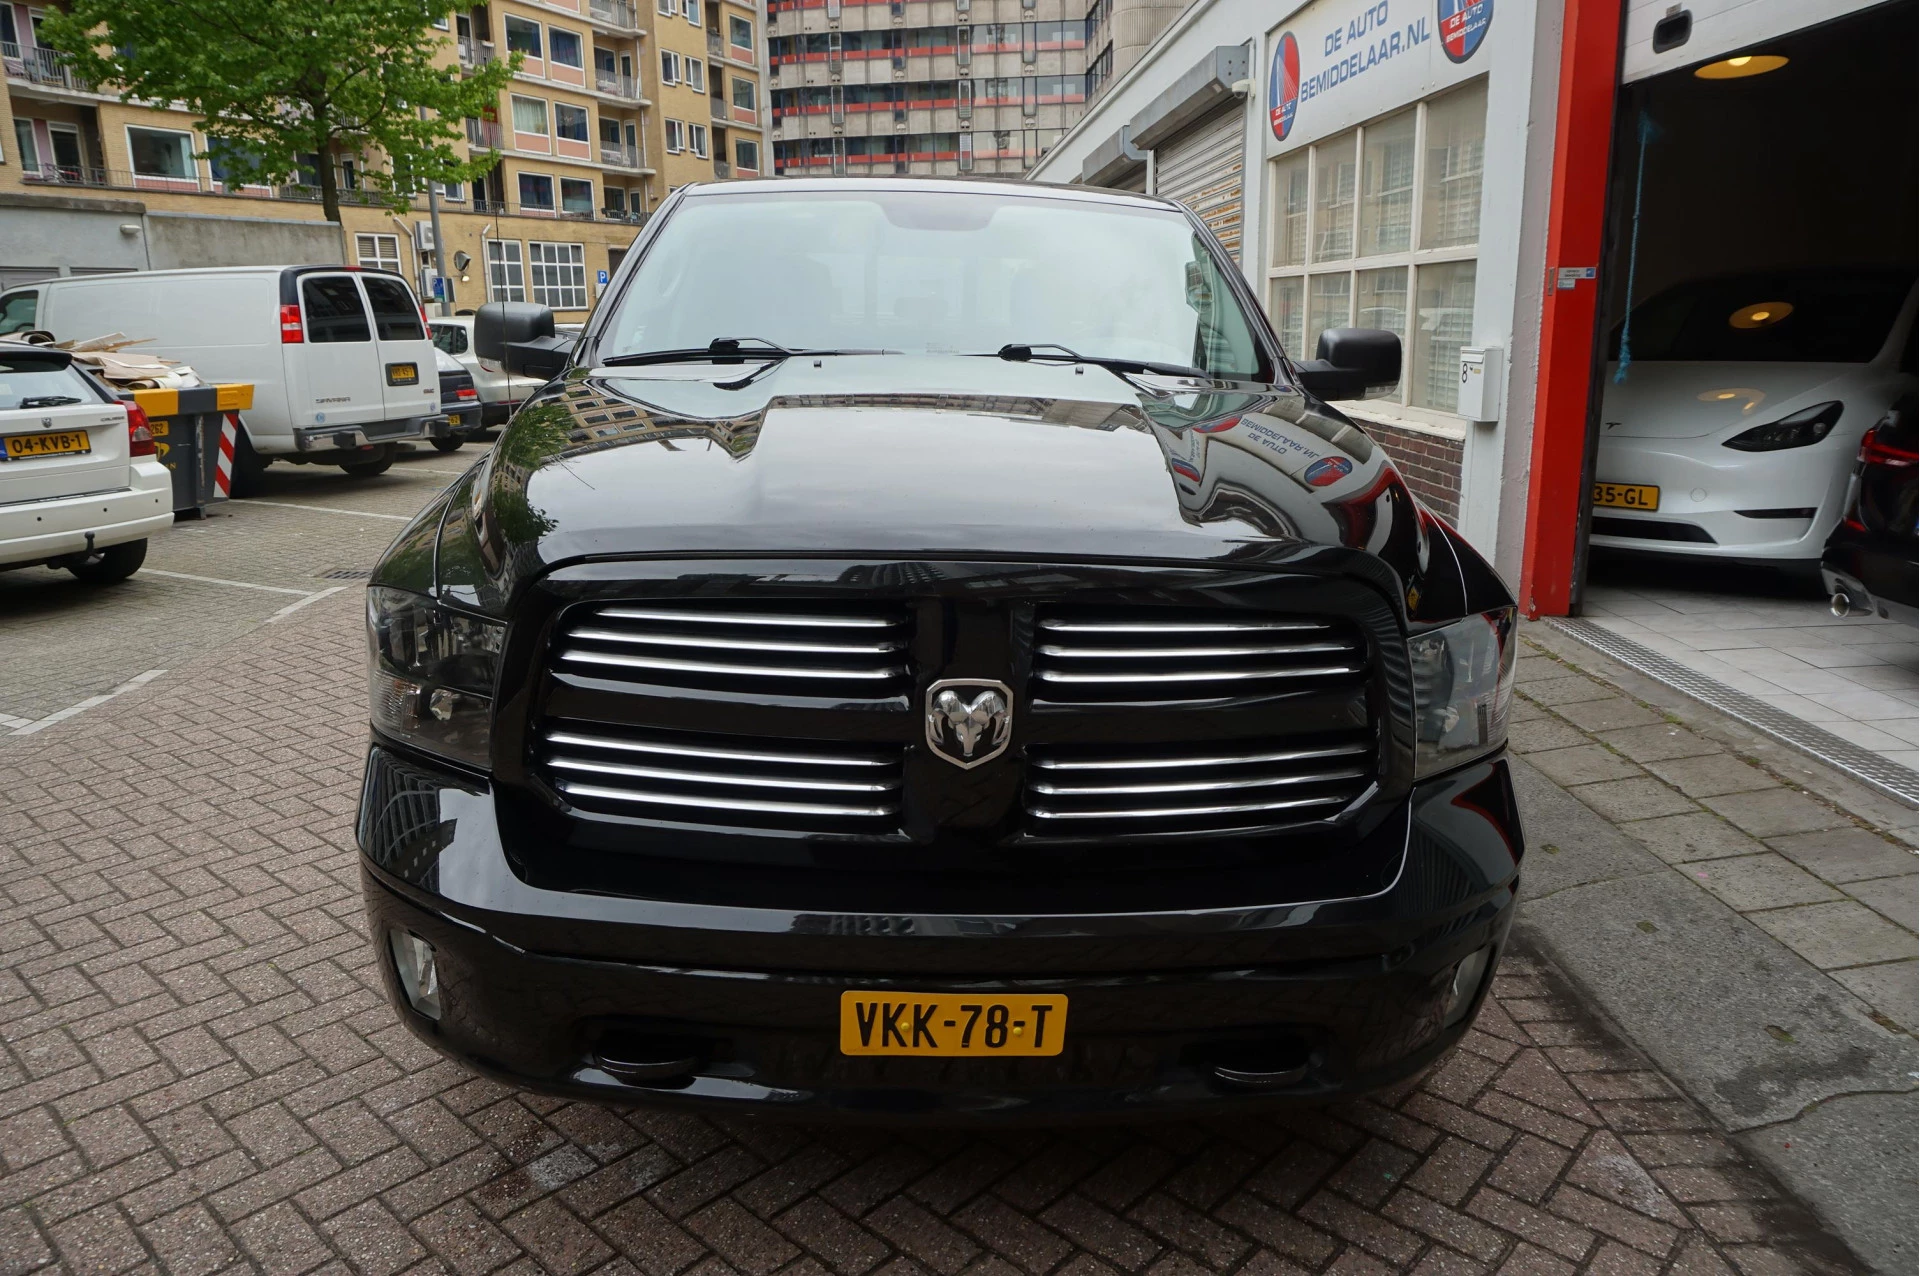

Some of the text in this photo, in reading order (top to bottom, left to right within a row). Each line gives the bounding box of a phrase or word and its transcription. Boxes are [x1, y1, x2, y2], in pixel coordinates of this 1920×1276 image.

[1325, 0, 1388, 57] DE AUTO
[1450, 4, 1483, 29] DE AUTO
[1301, 16, 1430, 103] BEMIDDELAAR.NL
[599, 271, 606, 283] P
[1461, 362, 1468, 384] 8
[11, 434, 82, 454] 04-KVB-1
[855, 1002, 1053, 1048] VKK-78-T
